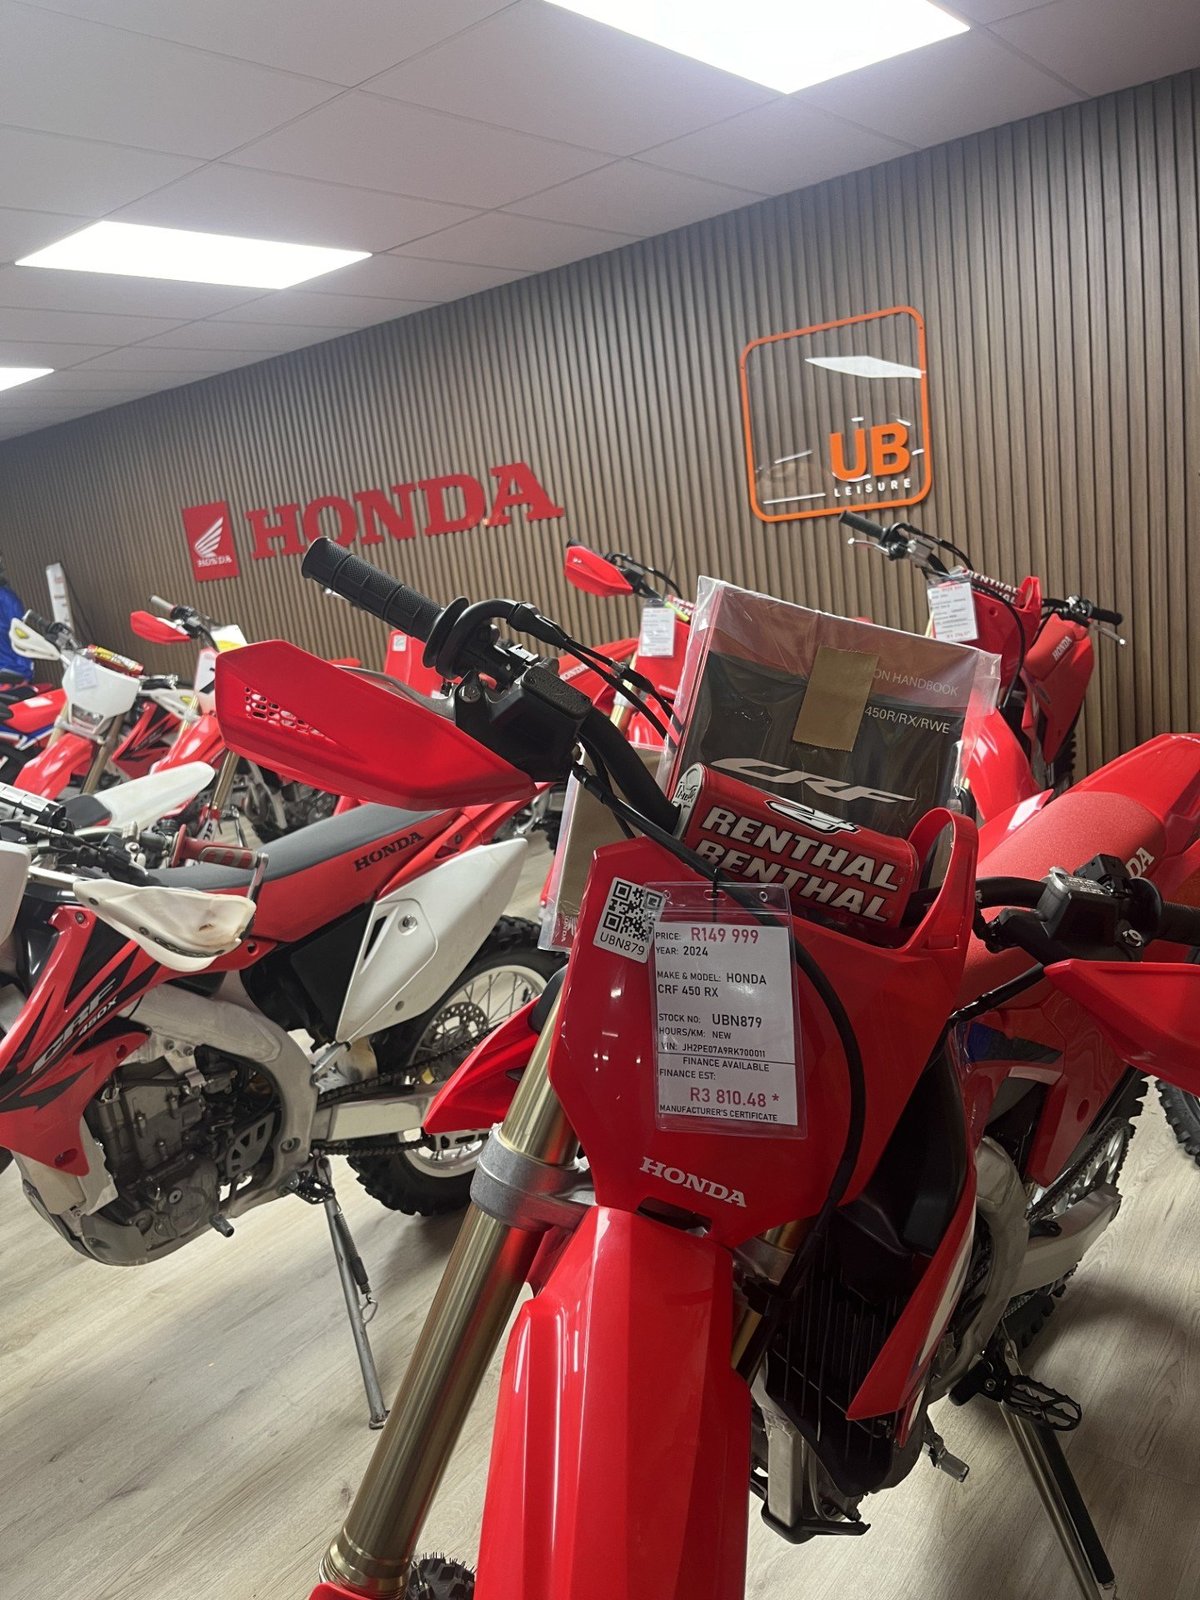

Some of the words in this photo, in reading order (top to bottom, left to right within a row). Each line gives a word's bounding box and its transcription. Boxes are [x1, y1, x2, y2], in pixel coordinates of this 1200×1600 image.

[830, 423, 911, 481] UB
[834, 477, 911, 497] LEISURE
[246, 462, 563, 560] HONDA
[198, 555, 232, 567] HONDA
[893, 672, 959, 697] HANDBOOK
[865, 706, 951, 734] 450R/RX/RWE
[711, 758, 916, 803] CRF
[354, 832, 424, 872] HONDA
[702, 806, 898, 891] RENTHAL
[600, 932, 645, 955] UBN879
[656, 932, 681, 940] PRICE:
[691, 927, 726, 942] R149
[732, 929, 759, 944] 999
[656, 947, 679, 955] YEAR:
[683, 946, 708, 956] 2024
[657, 971, 680, 979] MAKE
[690, 973, 721, 982] MODEL:
[726, 972, 767, 985] HONDA
[657, 984, 679, 994] CRF
[682, 986, 701, 996] 450
[704, 987, 719, 997] RX
[31, 978, 116, 1075] CRF
[659, 1013, 685, 1022] STOCK
[687, 1015, 701, 1023] NO:
[712, 1014, 762, 1028] UBN879
[659, 1027, 706, 1037] HOURS/KM:
[712, 1031, 731, 1039] NEW
[661, 1042, 678, 1051] VIN:
[660, 1069, 696, 1079] FINANCE
[698, 1071, 716, 1080] EST:
[683, 1057, 719, 1067] FINANCE
[721, 1060, 770, 1072] AVAILABLE
[690, 1087, 710, 1103] R3
[716, 1089, 767, 1108] 810.48
[660, 1104, 728, 1117] MANUFACTURER'S
[729, 1110, 778, 1122] CERTIFICATE
[639, 1156, 747, 1208] HONDA
